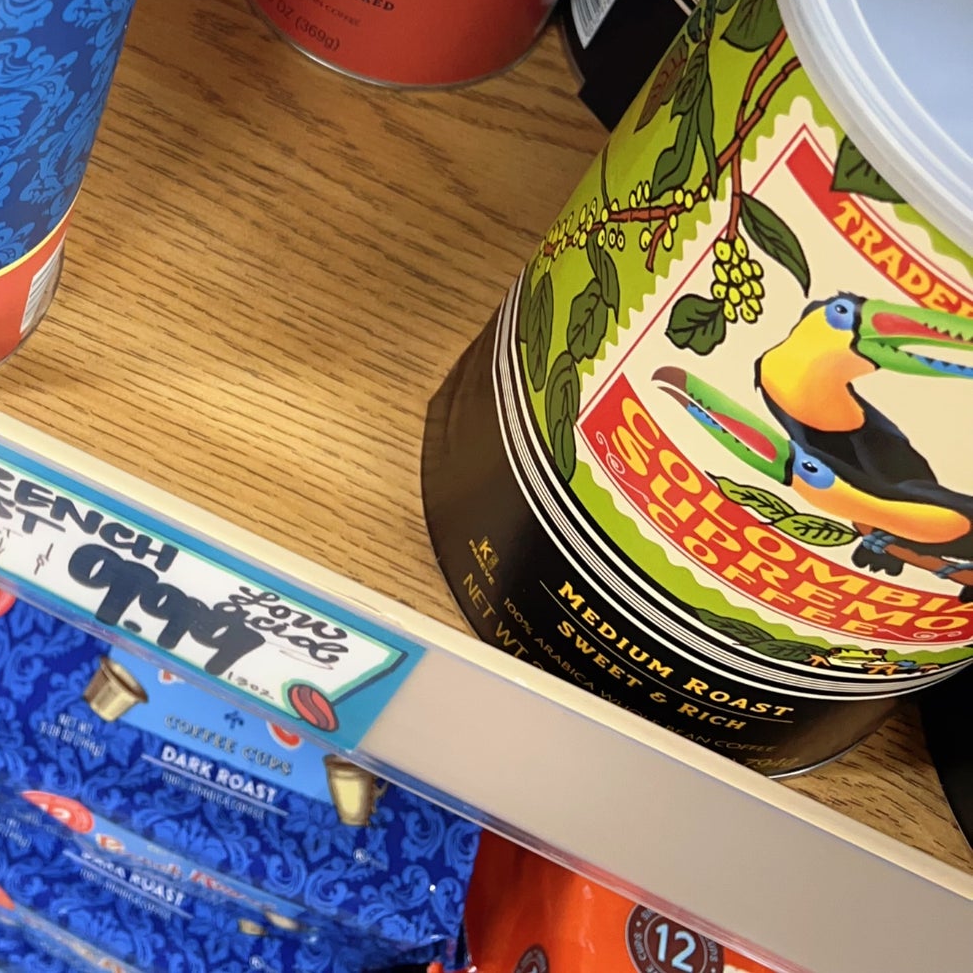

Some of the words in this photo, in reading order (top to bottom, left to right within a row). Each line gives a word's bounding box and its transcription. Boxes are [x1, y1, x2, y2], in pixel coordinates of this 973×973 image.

[295, 14, 341, 52] (369g)
[611, 424, 970, 631] SUPREMO
[463, 572, 496, 619] NET
[647, 502, 880, 637] COFFEE
[503, 597, 534, 636] 100%
[534, 636, 596, 691] ARABICA
[557, 619, 643, 689] SWEET
[649, 691, 669, 705] &
[677, 701, 747, 731] RICH
[558, 580, 674, 679] MEDIUM
[683, 676, 795, 718] ROAST
[160, 744, 214, 778] DARK
[216, 768, 277, 804] ROAST
[164, 715, 238, 754] COFFEE
[242, 745, 294, 777] CUPS
[655, 922, 698, 973] 12
